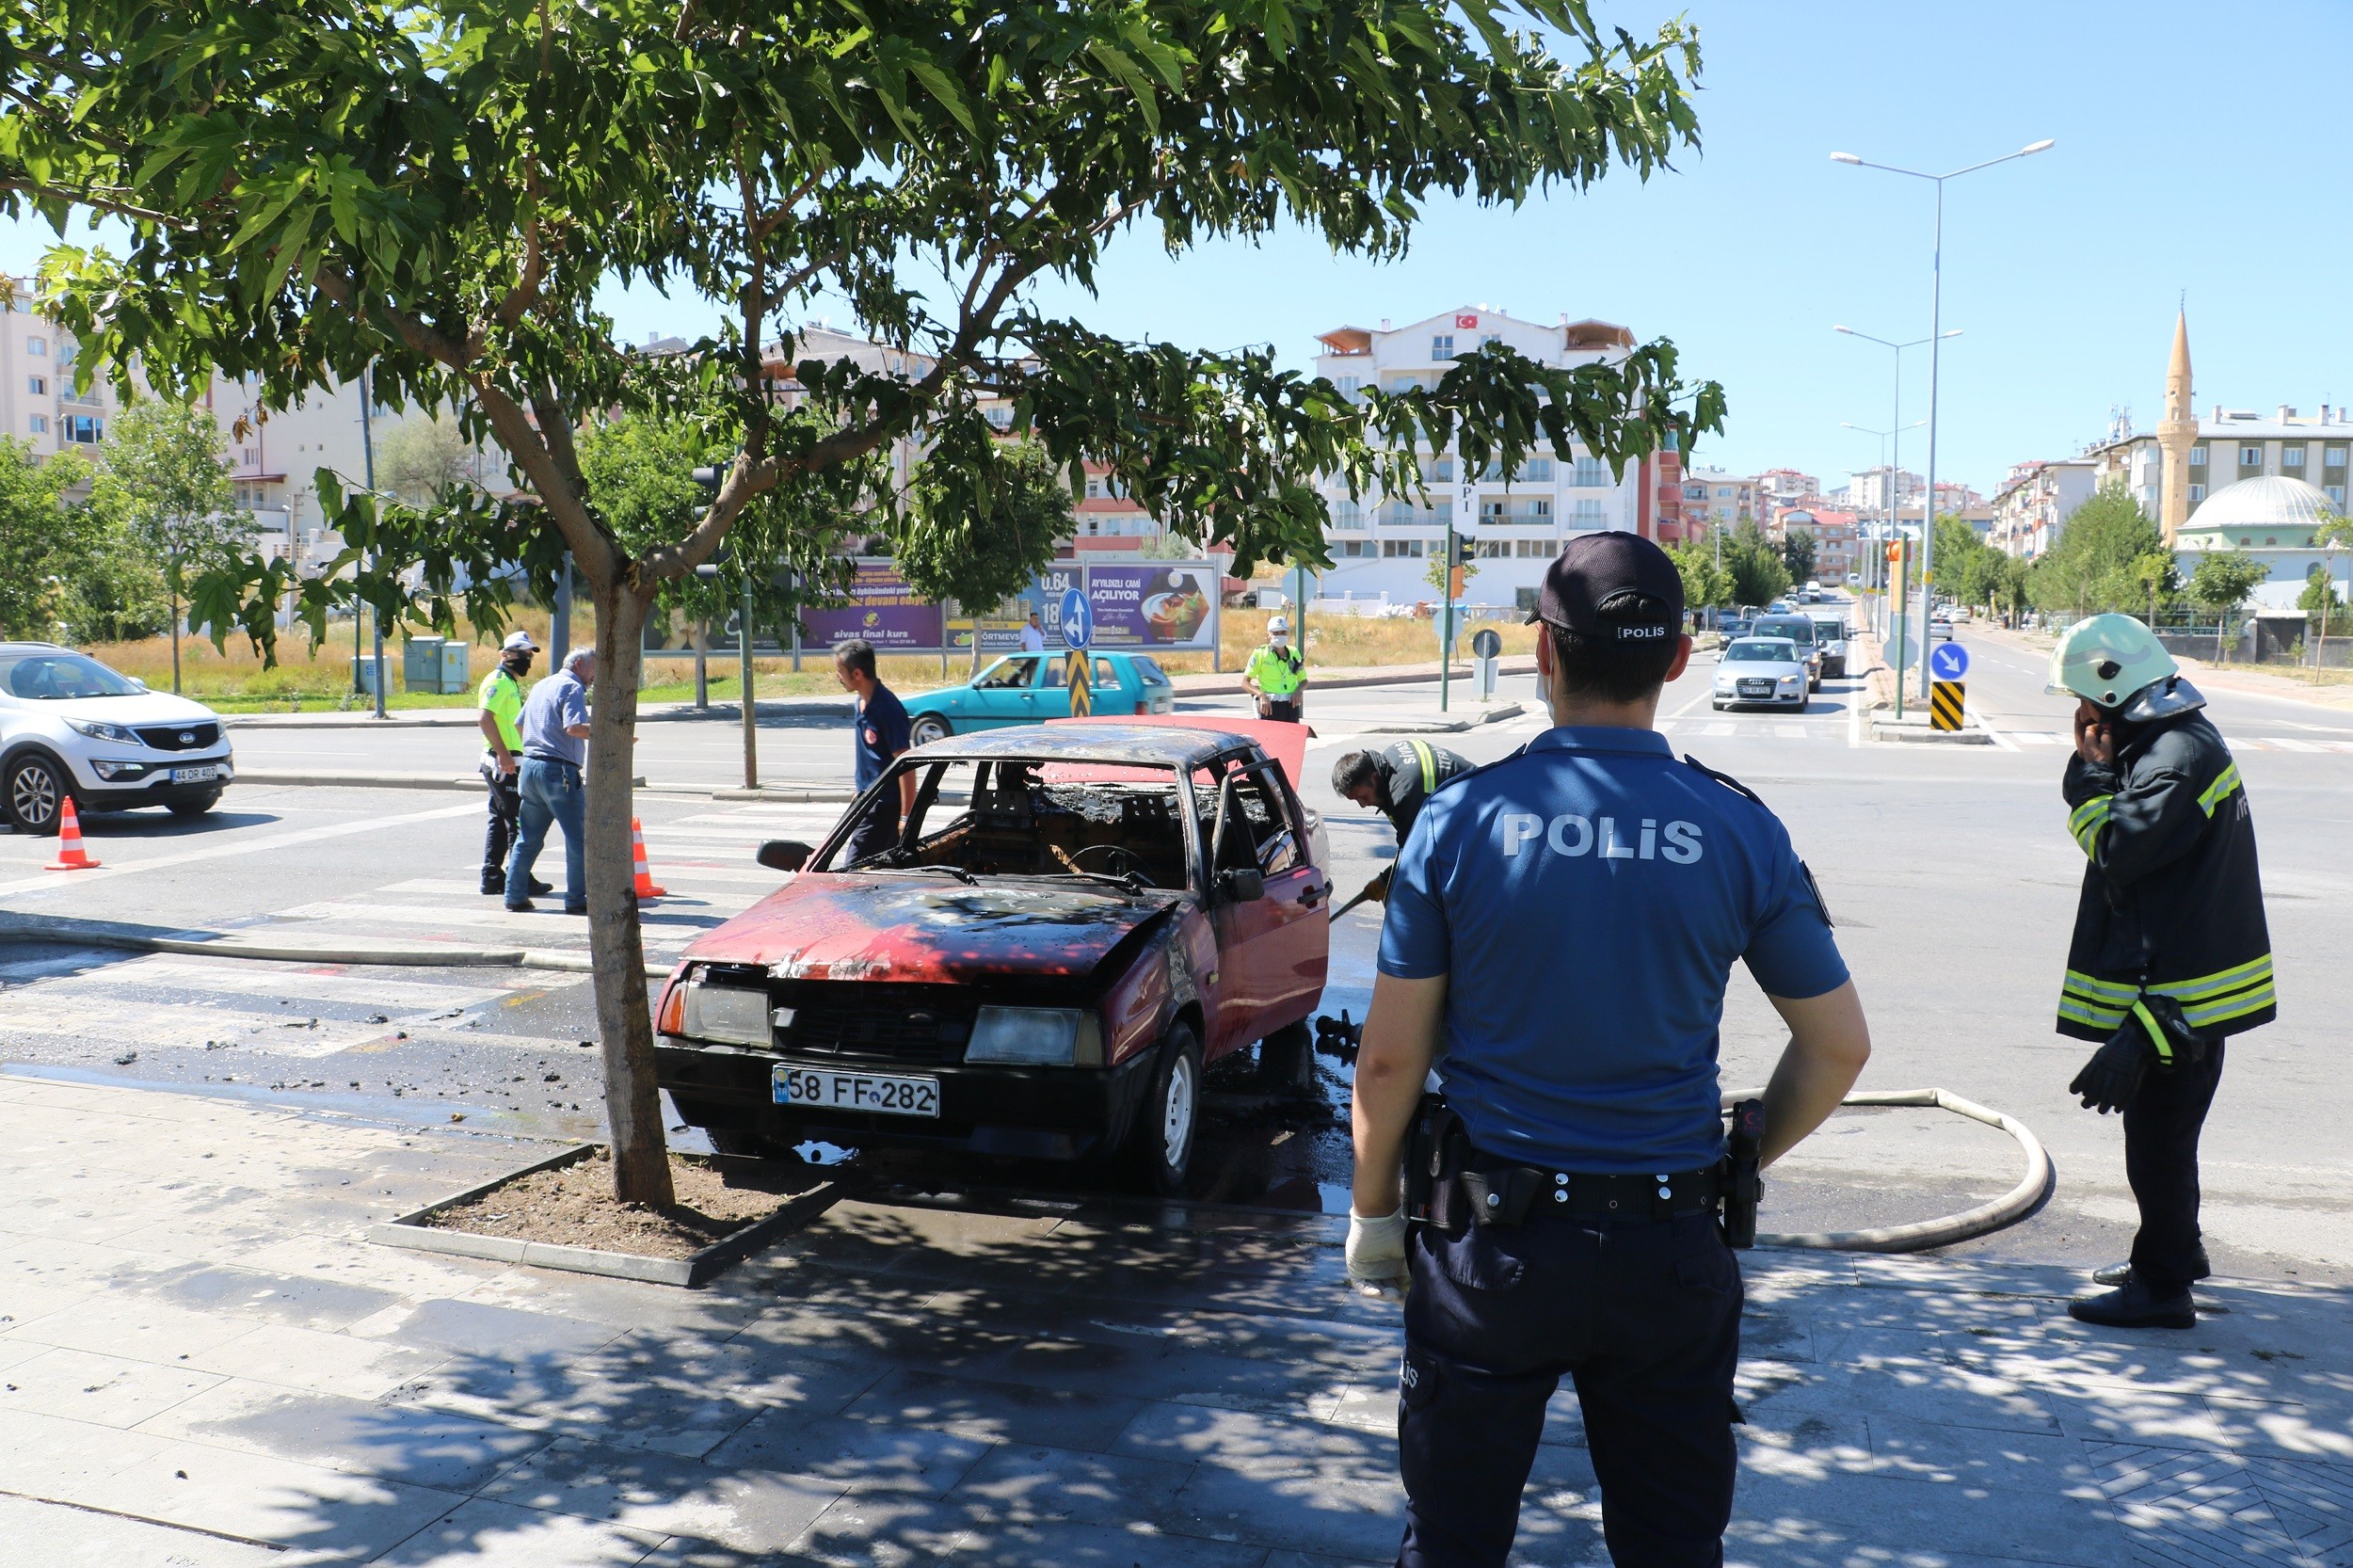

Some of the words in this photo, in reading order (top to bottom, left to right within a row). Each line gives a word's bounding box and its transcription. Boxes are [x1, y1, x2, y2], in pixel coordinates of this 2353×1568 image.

[1092, 579, 1123, 588] AYYILDIZLI
[1126, 578, 1141, 588] CAMİ
[865, 596, 898, 606] devam
[1092, 590, 1140, 602] AÇILIYOR
[834, 630, 860, 638] sivas
[862, 630, 885, 638] final
[887, 630, 908, 638] kurs
[982, 632, 1019, 640] ÖRTMEVS
[177, 771, 185, 780] 44
[188, 770, 199, 779] DR
[201, 767, 216, 777] 402
[778, 1087, 787, 1096] TR
[789, 1071, 821, 1100] 58
[834, 1077, 872, 1104] FF
[881, 1081, 932, 1112] 282
